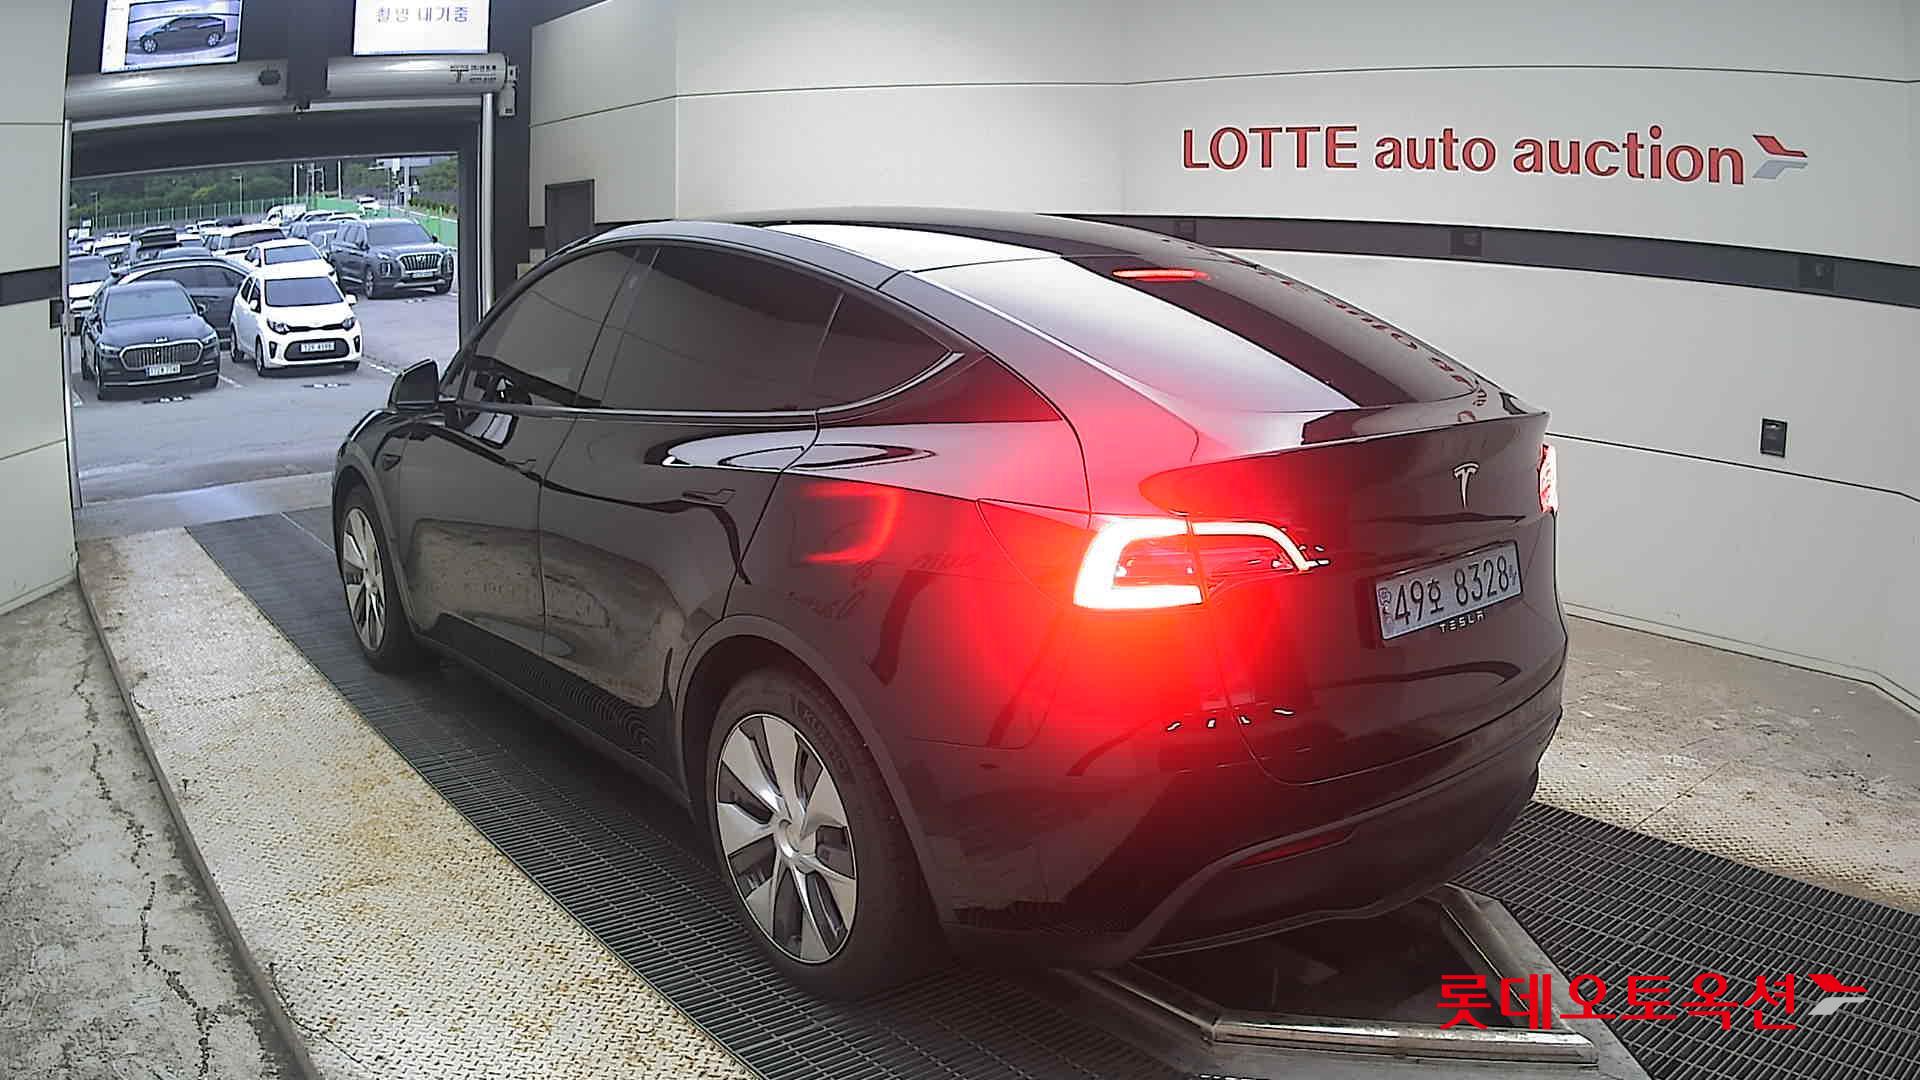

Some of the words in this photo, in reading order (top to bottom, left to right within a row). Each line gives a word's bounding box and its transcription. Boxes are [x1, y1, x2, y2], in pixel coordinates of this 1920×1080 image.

[1182, 125, 1358, 170] LOTTE
[1373, 127, 1497, 173] auto
[1512, 126, 1746, 185] auction
[1394, 577, 1445, 626] 49호
[1453, 554, 1509, 607] 8328
[1439, 610, 1486, 633] TESLA
